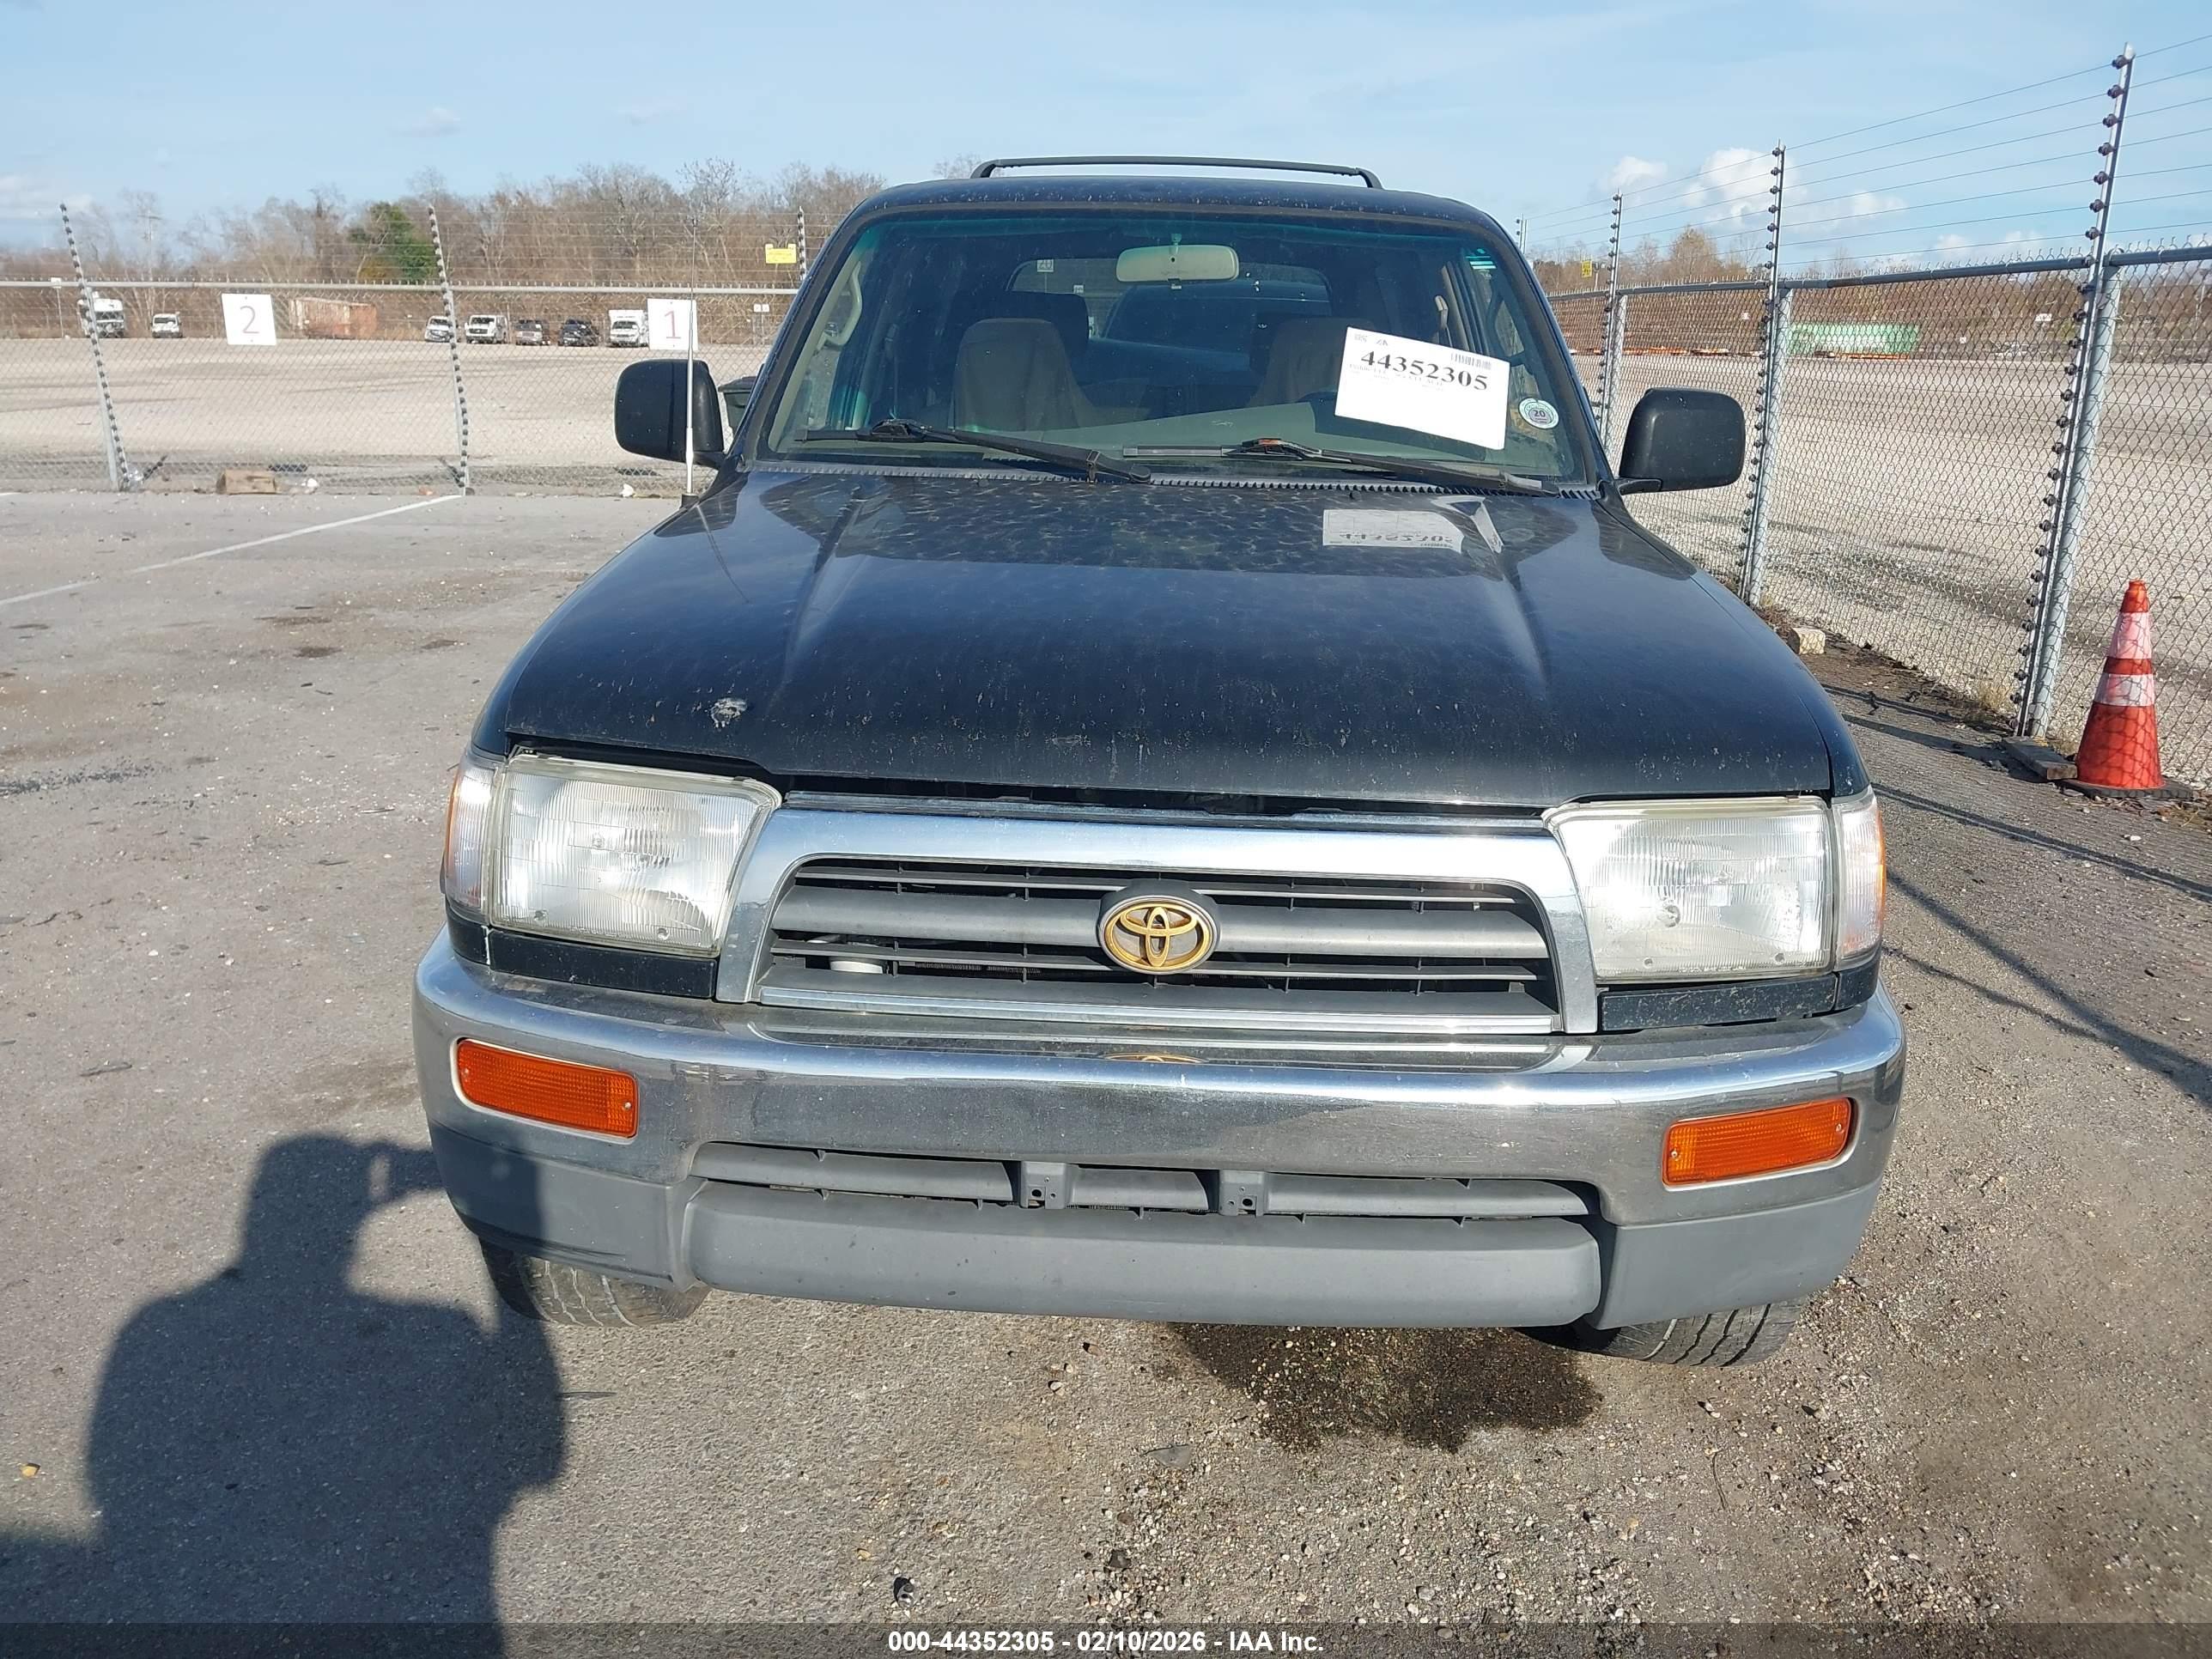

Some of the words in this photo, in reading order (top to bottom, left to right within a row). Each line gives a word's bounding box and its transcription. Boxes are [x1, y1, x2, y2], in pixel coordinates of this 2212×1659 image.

[240, 305, 260, 334] 2
[664, 310, 682, 339] 1
[1360, 350, 1488, 391] 44352305
[1533, 409, 1547, 417] 20
